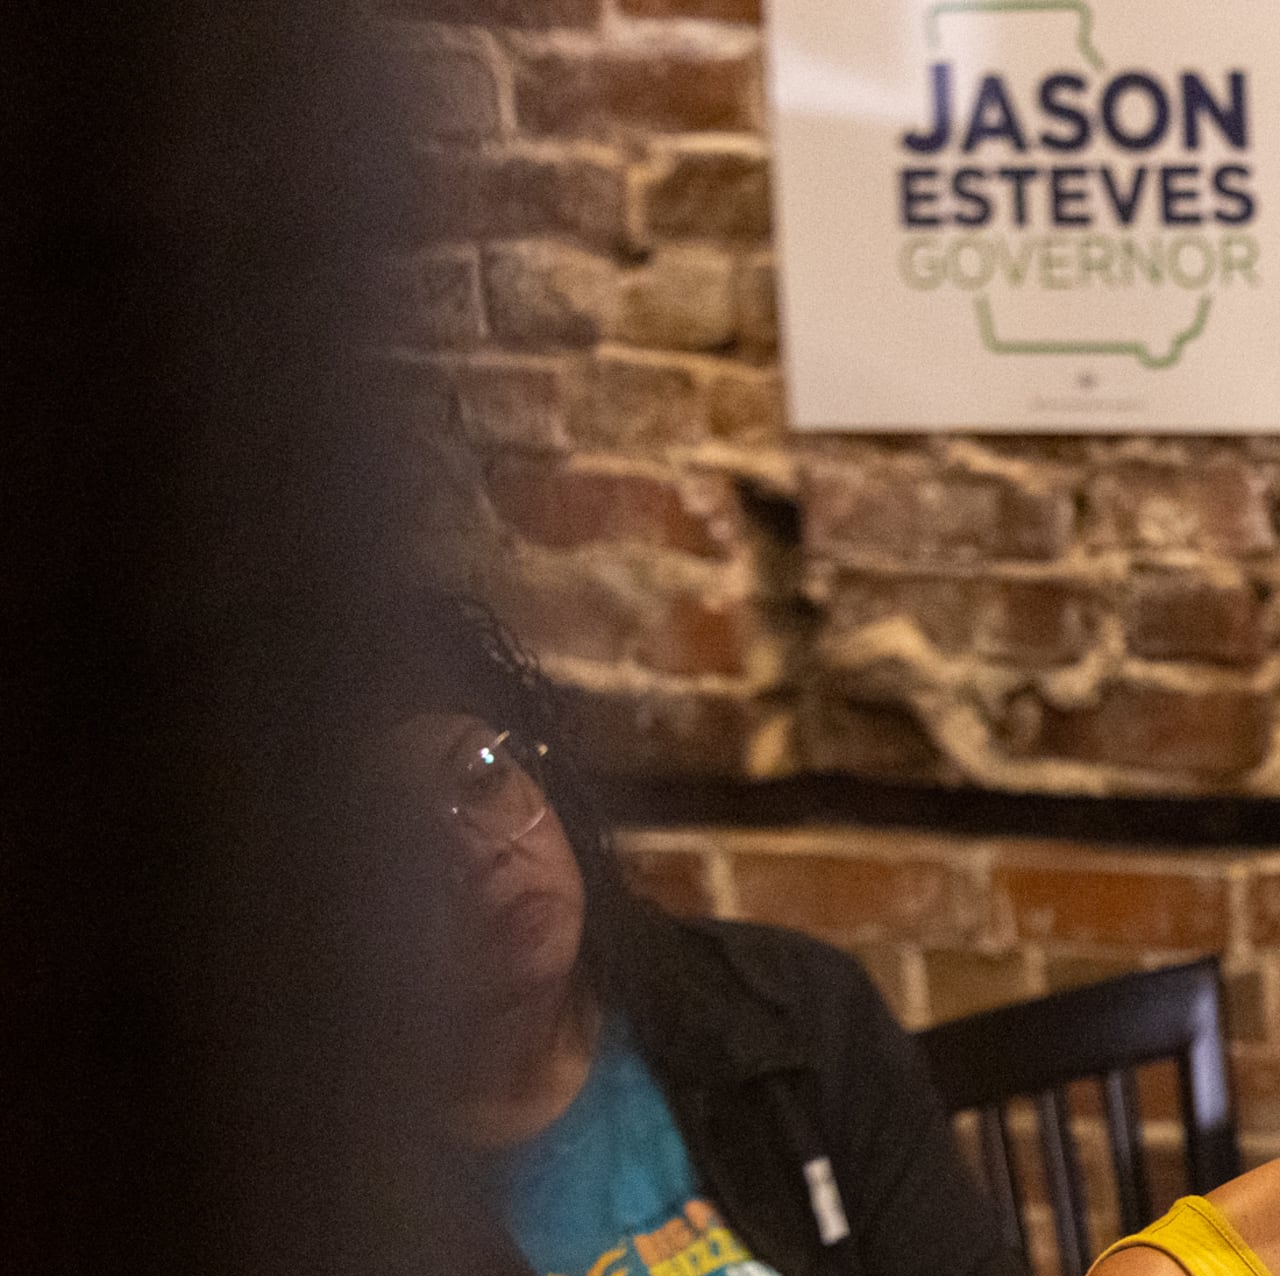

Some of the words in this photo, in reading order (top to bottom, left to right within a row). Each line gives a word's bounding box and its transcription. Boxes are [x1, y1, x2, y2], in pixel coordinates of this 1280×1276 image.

[902, 62, 1250, 154] JASON
[902, 164, 1258, 228] ESTEVES
[900, 233, 1262, 292] GOVERNOR
